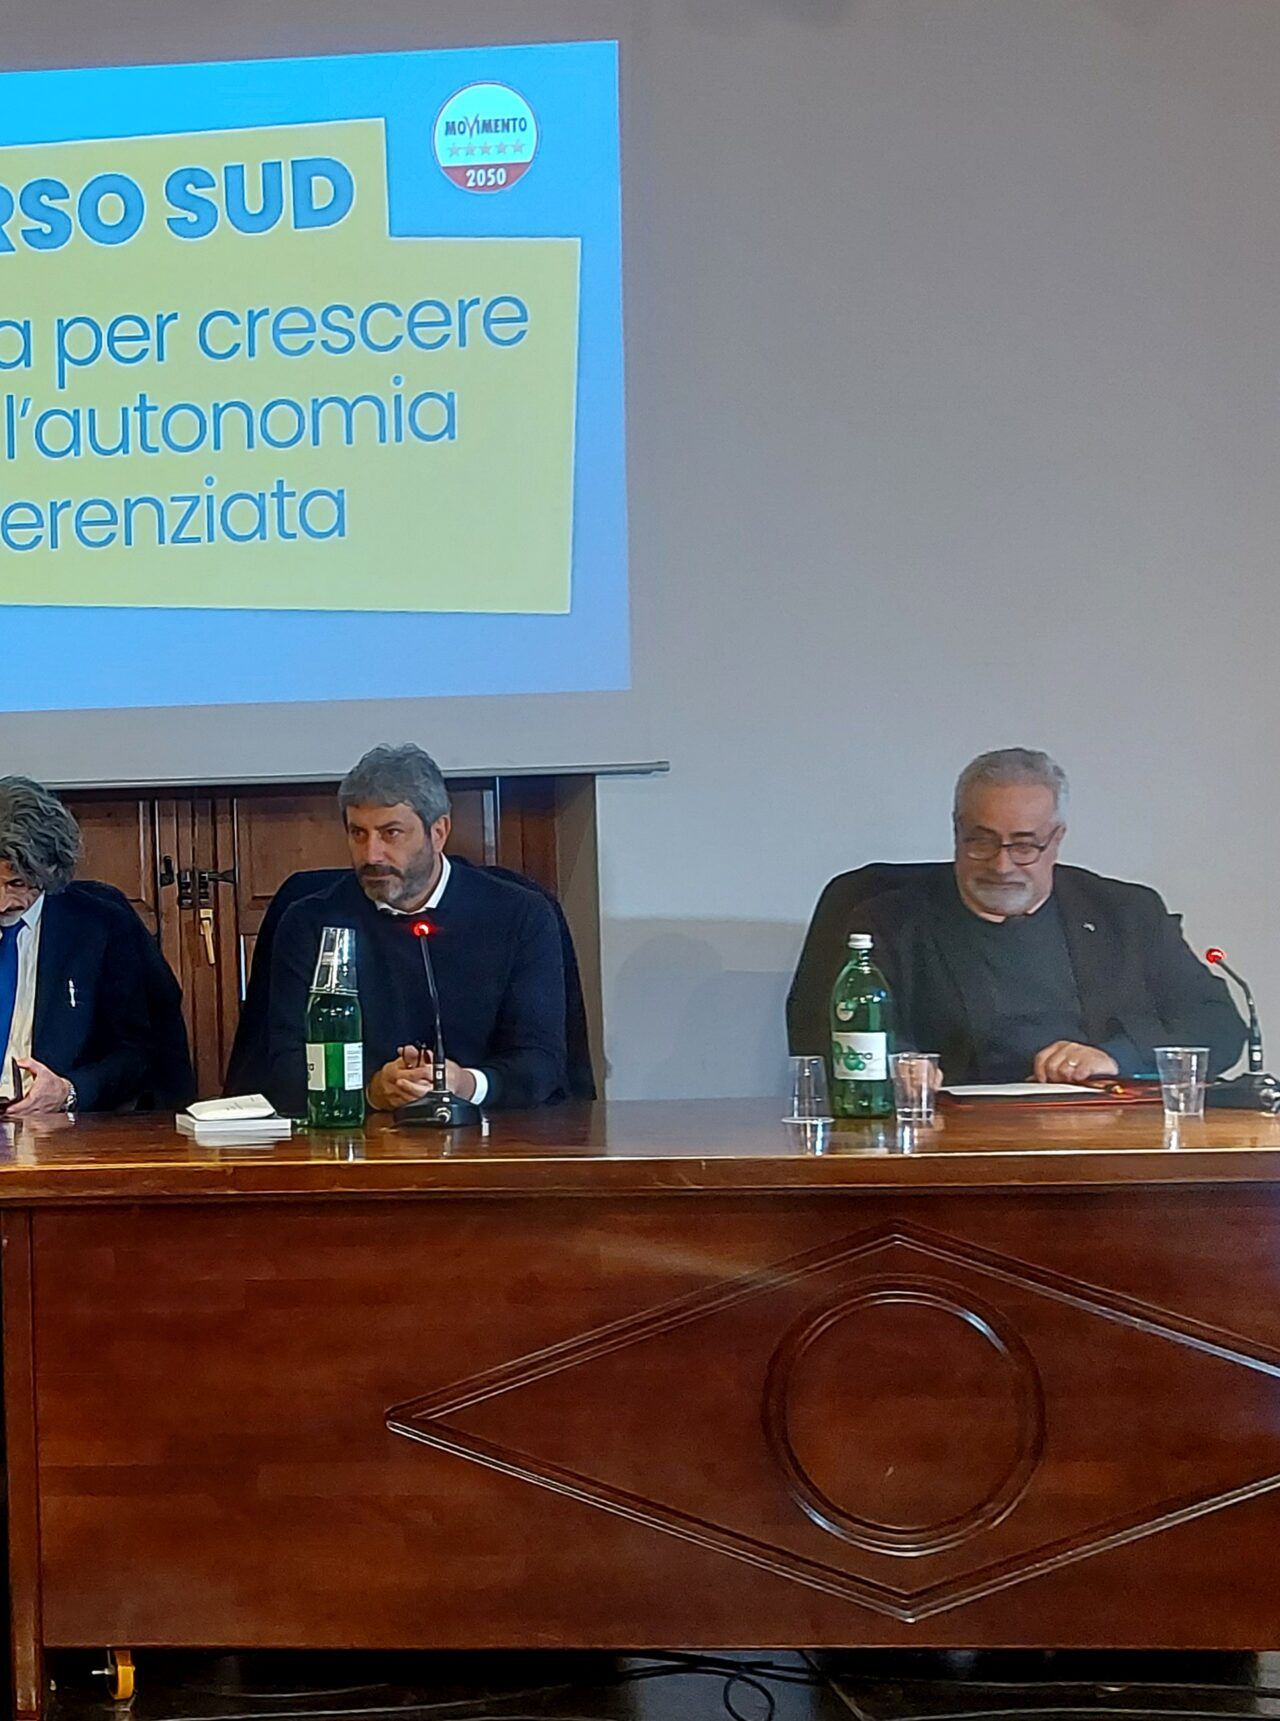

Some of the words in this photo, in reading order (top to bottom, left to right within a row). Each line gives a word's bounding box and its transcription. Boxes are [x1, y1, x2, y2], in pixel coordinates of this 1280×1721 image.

[445, 114, 527, 137] MOVIMENTO
[164, 157, 354, 239] SUD
[466, 167, 506, 187] 2050
[56, 304, 179, 390] per
[198, 295, 529, 363] crescere
[6, 375, 456, 460] l'autonomia
